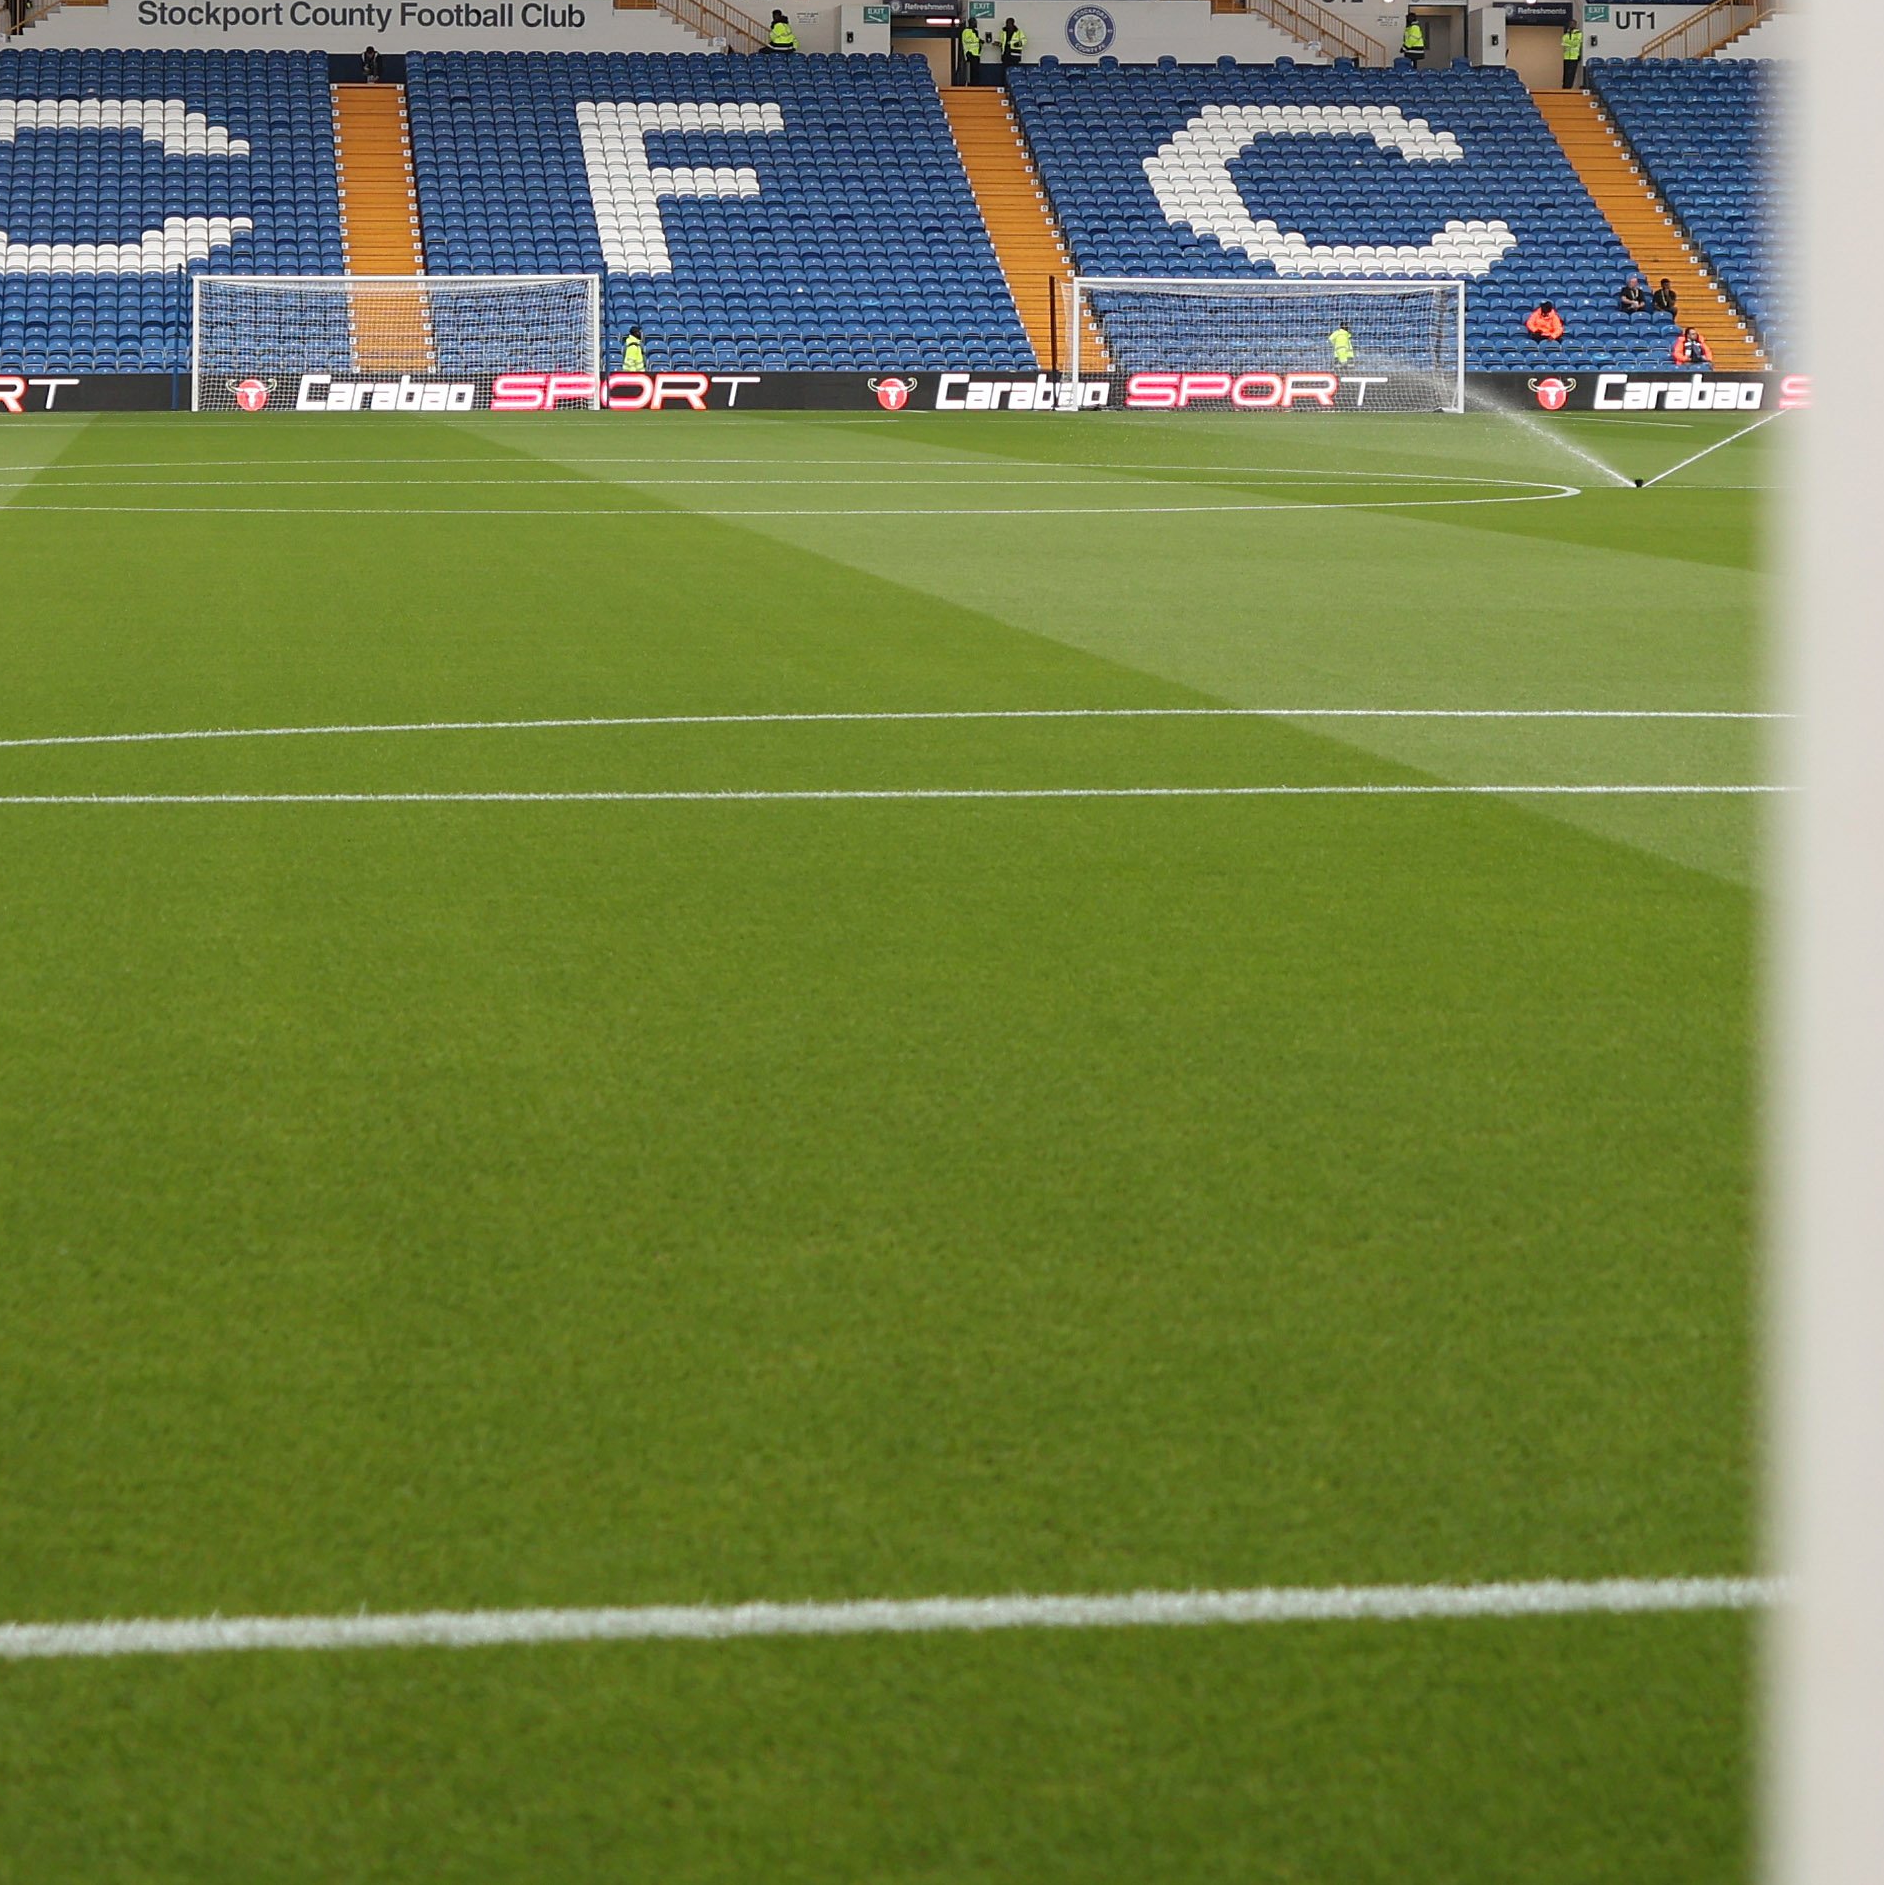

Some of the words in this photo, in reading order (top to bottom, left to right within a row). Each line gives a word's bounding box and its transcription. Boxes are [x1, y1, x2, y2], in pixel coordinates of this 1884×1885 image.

[137, 0, 284, 32] Stockport
[289, 1, 393, 33] County
[400, 2, 514, 29] Football
[520, 2, 585, 29] Club
[904, 2, 955, 12] Refreshments
[973, 2, 990, 10] EXIT
[1517, 6, 1567, 16] Refreshments
[1588, 6, 1605, 14] EXIT
[1615, 11, 1656, 30] UT1
[576, 101, 784, 276] F
[1142, 105, 1516, 279] C
[295, 374, 476, 411] Carabao
[490, 372, 761, 411] SPORT
[935, 373, 1111, 411] Carabao
[1125, 372, 1389, 409] SPORT
[1593, 373, 1764, 410] Carabao
